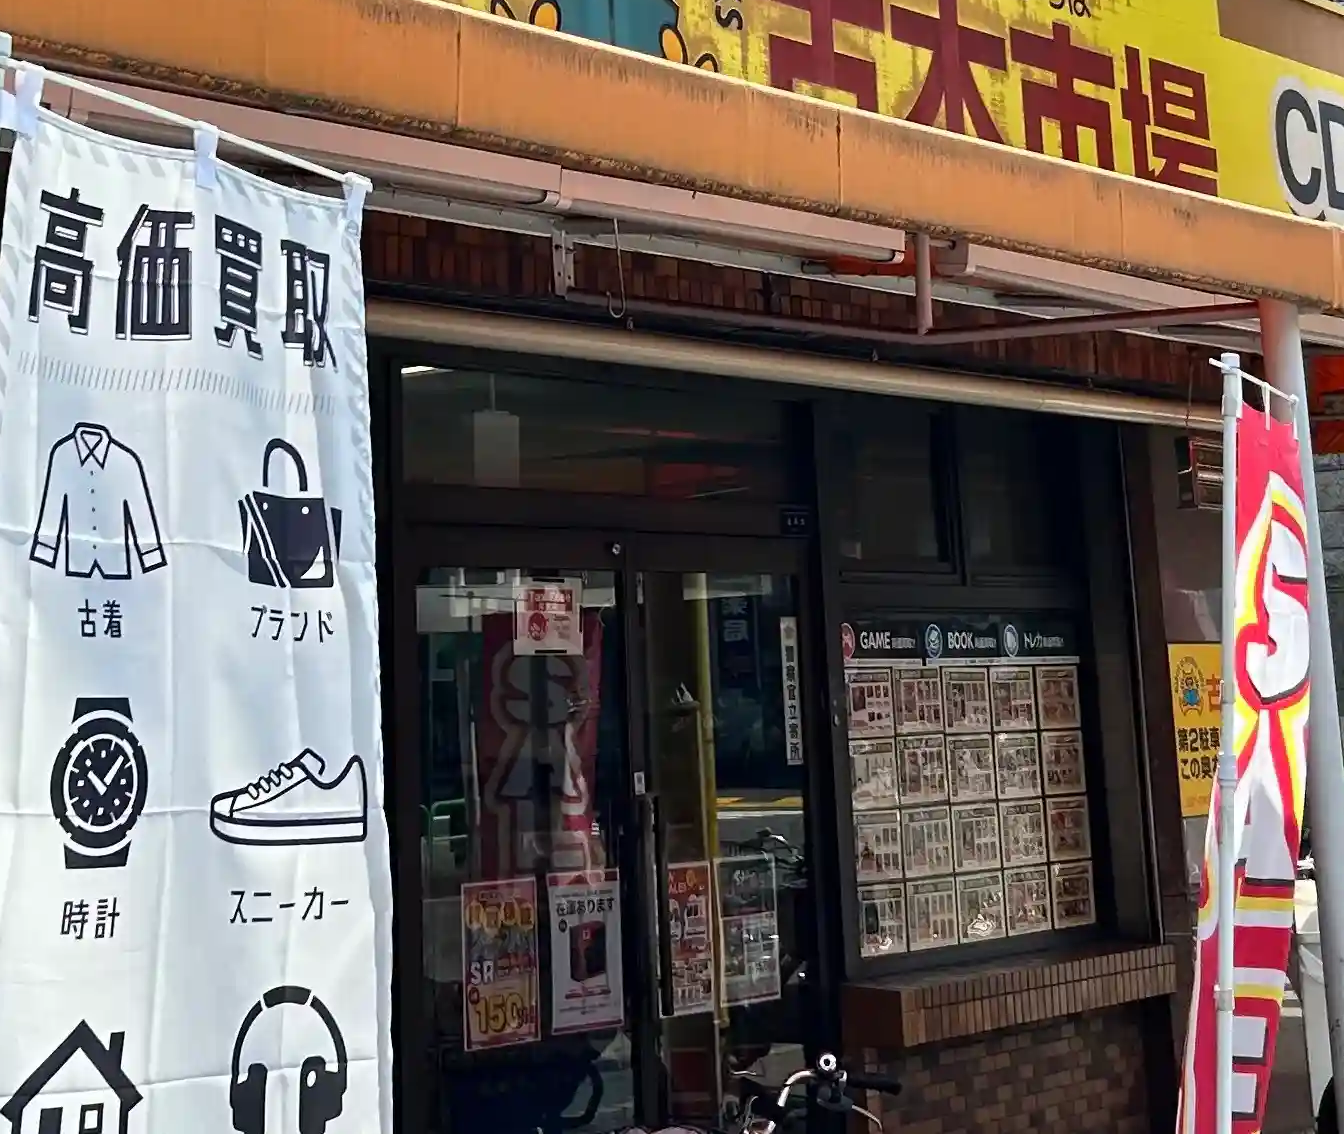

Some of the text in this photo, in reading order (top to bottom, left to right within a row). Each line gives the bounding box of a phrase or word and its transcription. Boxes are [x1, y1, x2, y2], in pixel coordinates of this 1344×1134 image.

[29, 187, 338, 371] 高価買取
[76, 597, 125, 640] 古着
[248, 604, 336, 644] ブランド
[859, 631, 891, 649] GAME
[947, 632, 975, 649] BOOK
[1206, 674, 1221, 713] 古
[1177, 727, 1220, 753] 第2駐車
[59, 897, 121, 941] 時計
[227, 886, 351, 928] スニーカー
